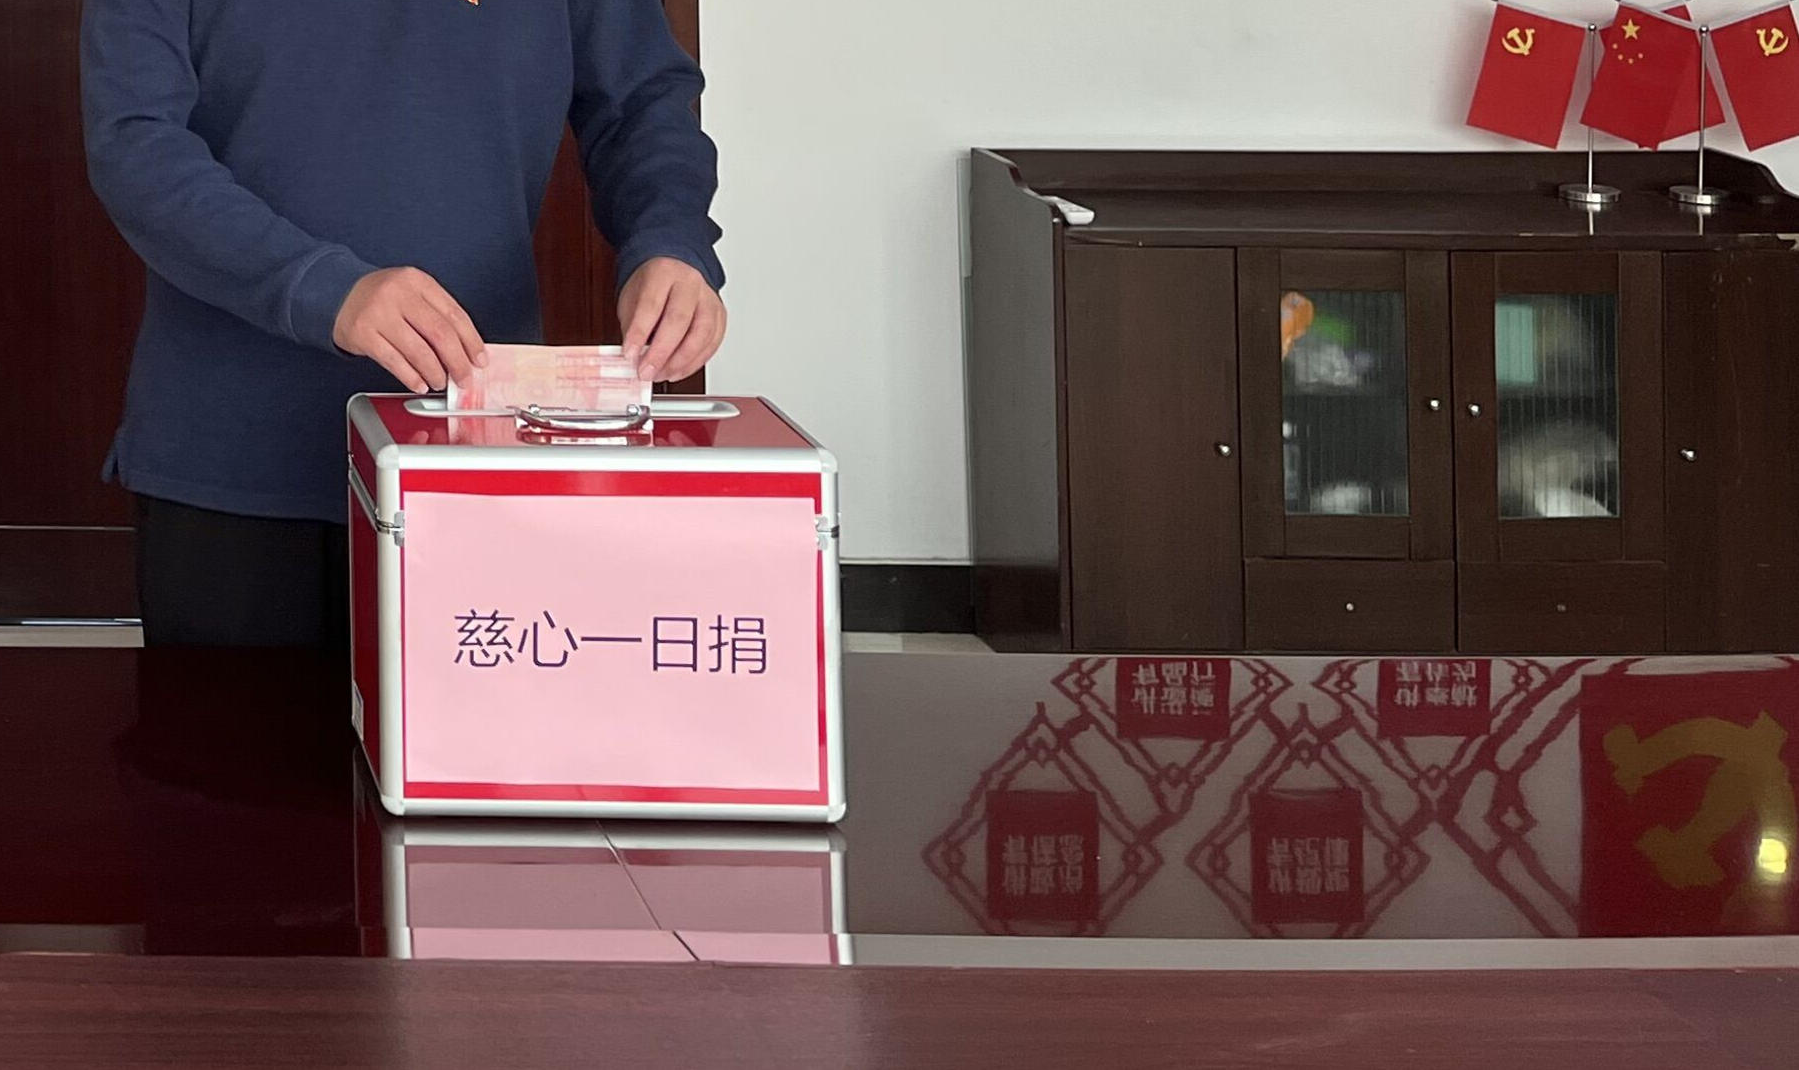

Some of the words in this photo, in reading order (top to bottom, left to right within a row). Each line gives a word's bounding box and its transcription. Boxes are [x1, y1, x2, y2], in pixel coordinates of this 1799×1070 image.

[453, 608, 769, 675] 慈心一日捐
